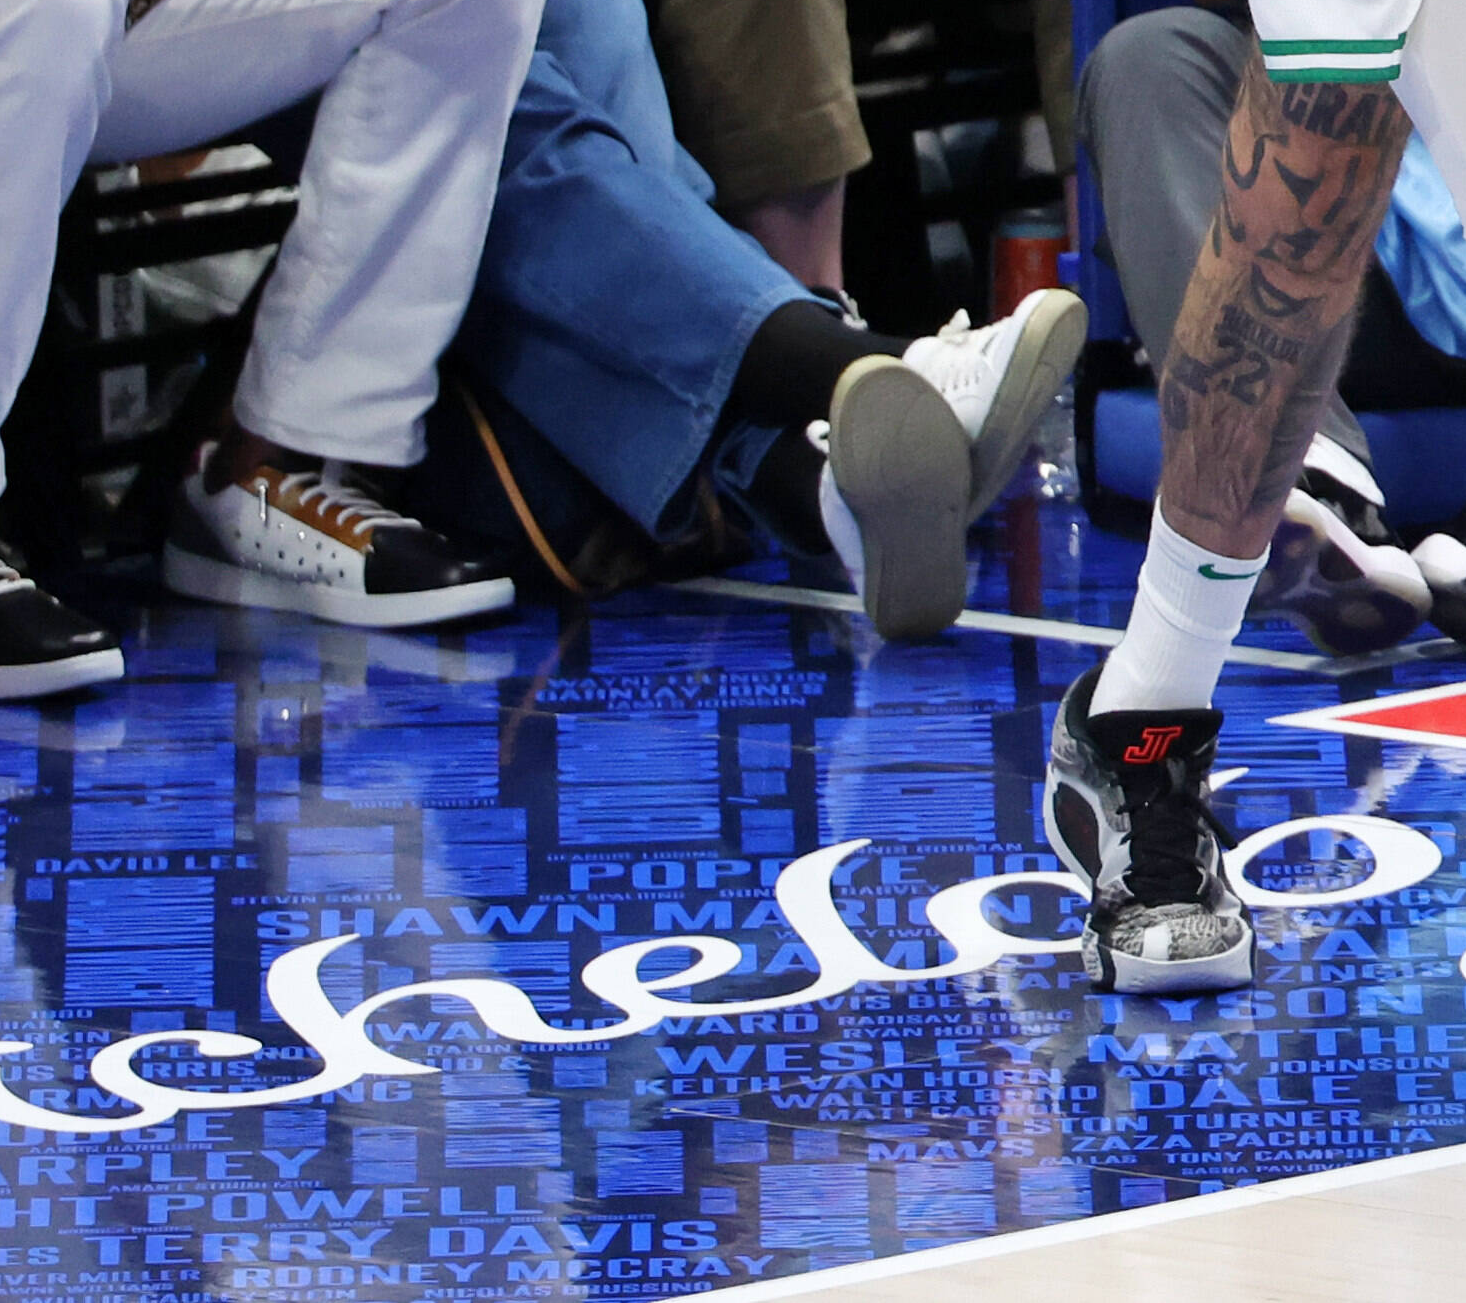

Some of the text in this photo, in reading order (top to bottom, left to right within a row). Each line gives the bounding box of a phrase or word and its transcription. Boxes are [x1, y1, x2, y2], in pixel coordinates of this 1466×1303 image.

[35, 853, 259, 874] DAVID LEE
[256, 903, 616, 939] SHAWN
[1086, 984, 1424, 1024] TYSON
[654, 1036, 1052, 1077] WESLEY
[1116, 1061, 1248, 1079] AVERY
[1267, 1055, 1451, 1075] JOHNSON
[632, 1067, 1062, 1096] KEITH VAN HORN
[770, 1087, 958, 1111] WALTER
[1128, 1074, 1361, 1111] DALE
[817, 1106, 913, 1122] MATT
[966, 1109, 1361, 1137] ELSTON TURNER
[866, 1128, 1435, 1163] MAVS ZAZA PACHULIA
[1165, 1150, 1246, 1166] TONY
[147, 1184, 544, 1225] POWELL
[84, 1219, 718, 1266] TERRY DAVIS
[78, 1268, 202, 1285] MILLER
[233, 1260, 484, 1290] RODNEY
[506, 1254, 776, 1284] MCCRAY
